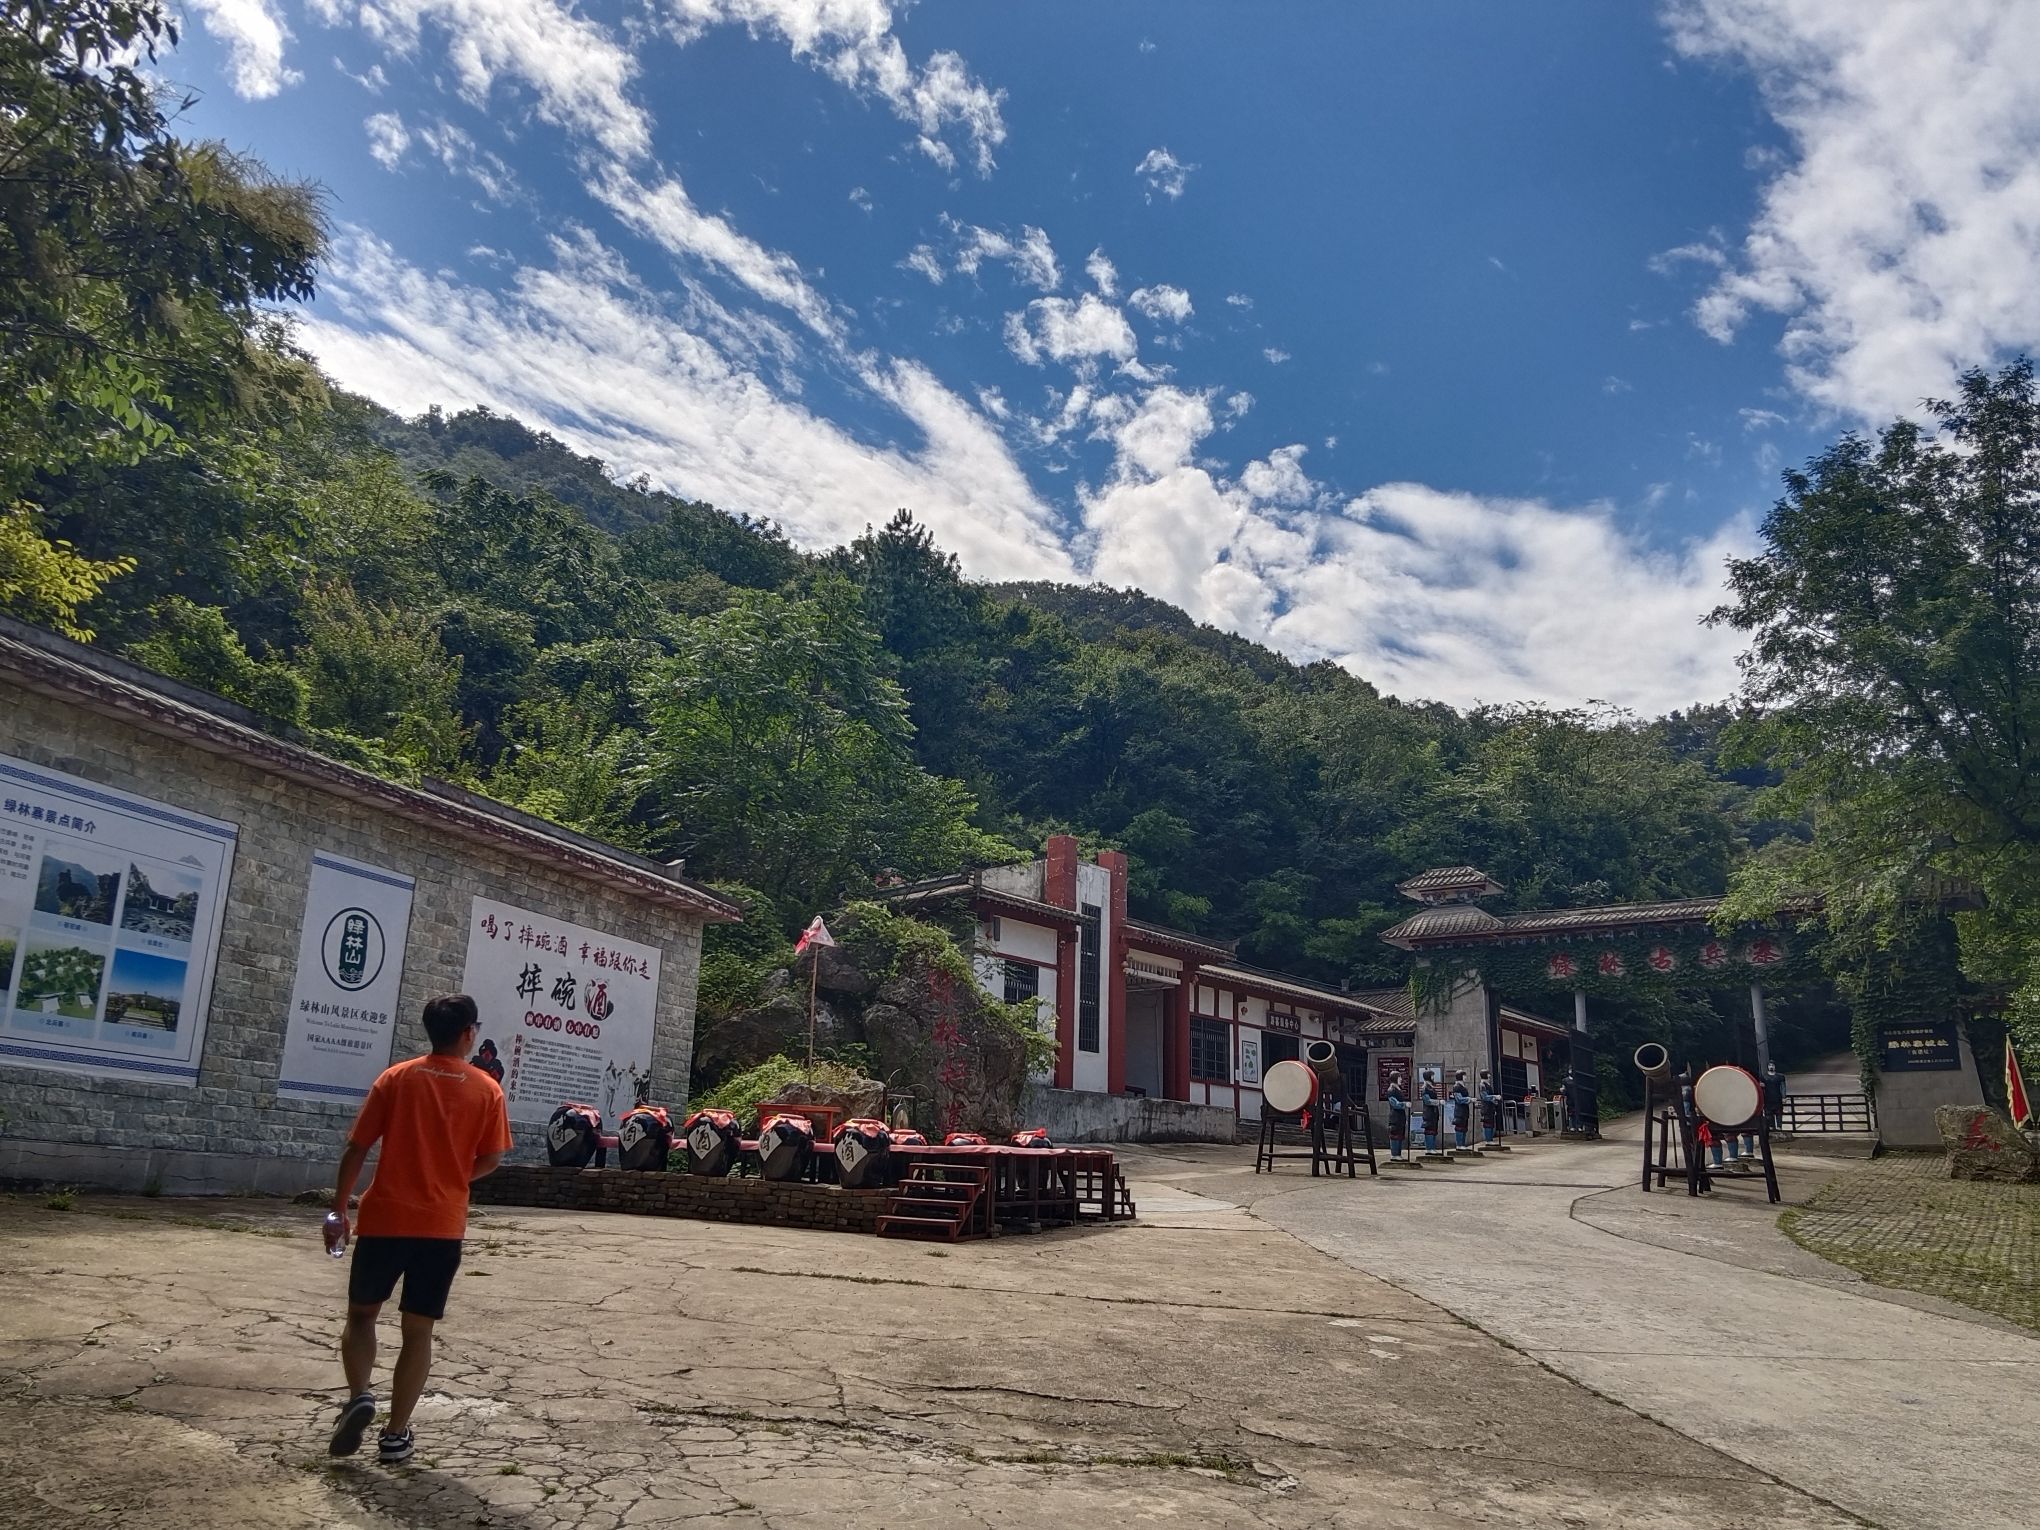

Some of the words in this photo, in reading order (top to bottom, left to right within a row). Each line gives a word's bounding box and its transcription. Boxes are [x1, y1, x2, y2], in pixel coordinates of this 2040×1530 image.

[3, 798, 96, 834] 绿林寨景点简介
[481, 914, 568, 957] 喝了摔碗酒
[578, 941, 651, 980] 幸福跟你走
[300, 999, 388, 1024] 绿林山风景区欢迎您
[516, 962, 608, 1019] 摔碗酒
[508, 1033, 523, 1102] 摔碗酒的来历
